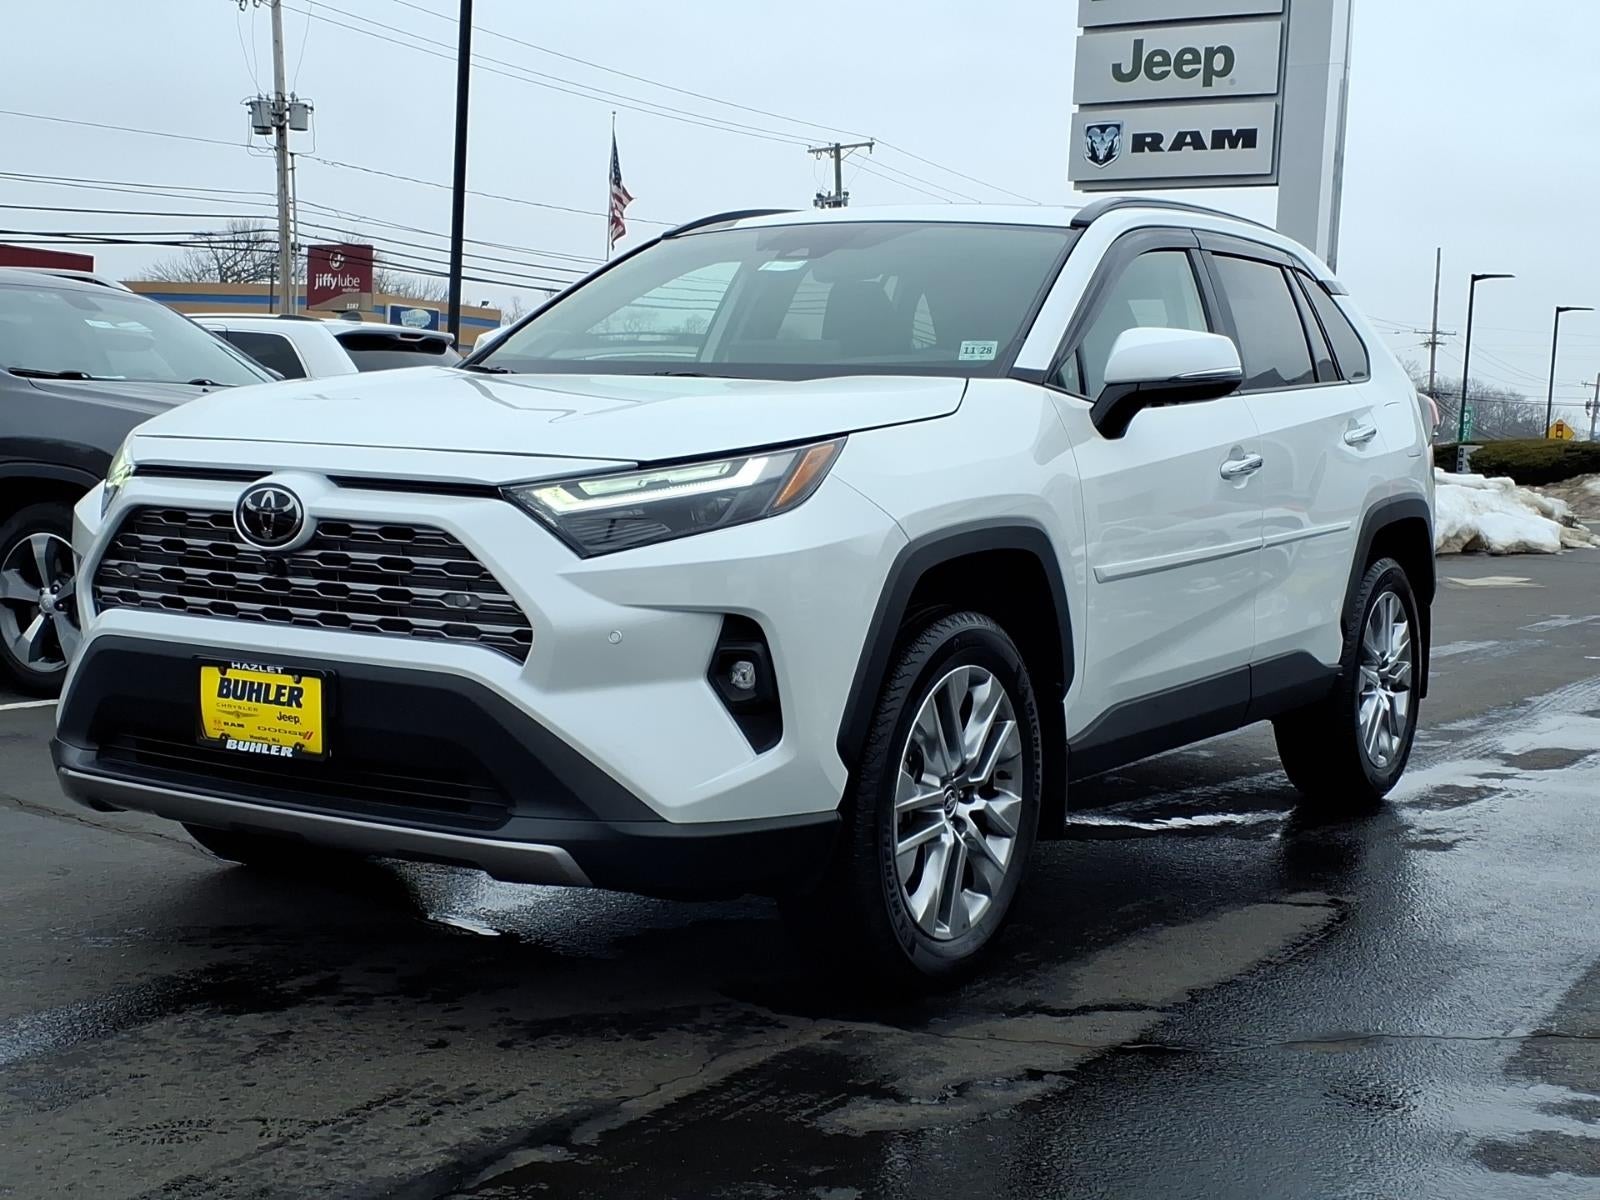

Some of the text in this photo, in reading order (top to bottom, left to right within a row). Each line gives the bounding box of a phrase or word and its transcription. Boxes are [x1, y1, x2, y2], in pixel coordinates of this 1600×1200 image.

[1111, 38, 1235, 88] Jeep
[1131, 128, 1258, 154] RAM
[231, 662, 284, 674] HAZLET
[217, 677, 304, 709] BUHLER
[216, 702, 259, 712] CHRYSLER
[223, 721, 245, 729] RAM
[226, 739, 293, 757] BUHLER
